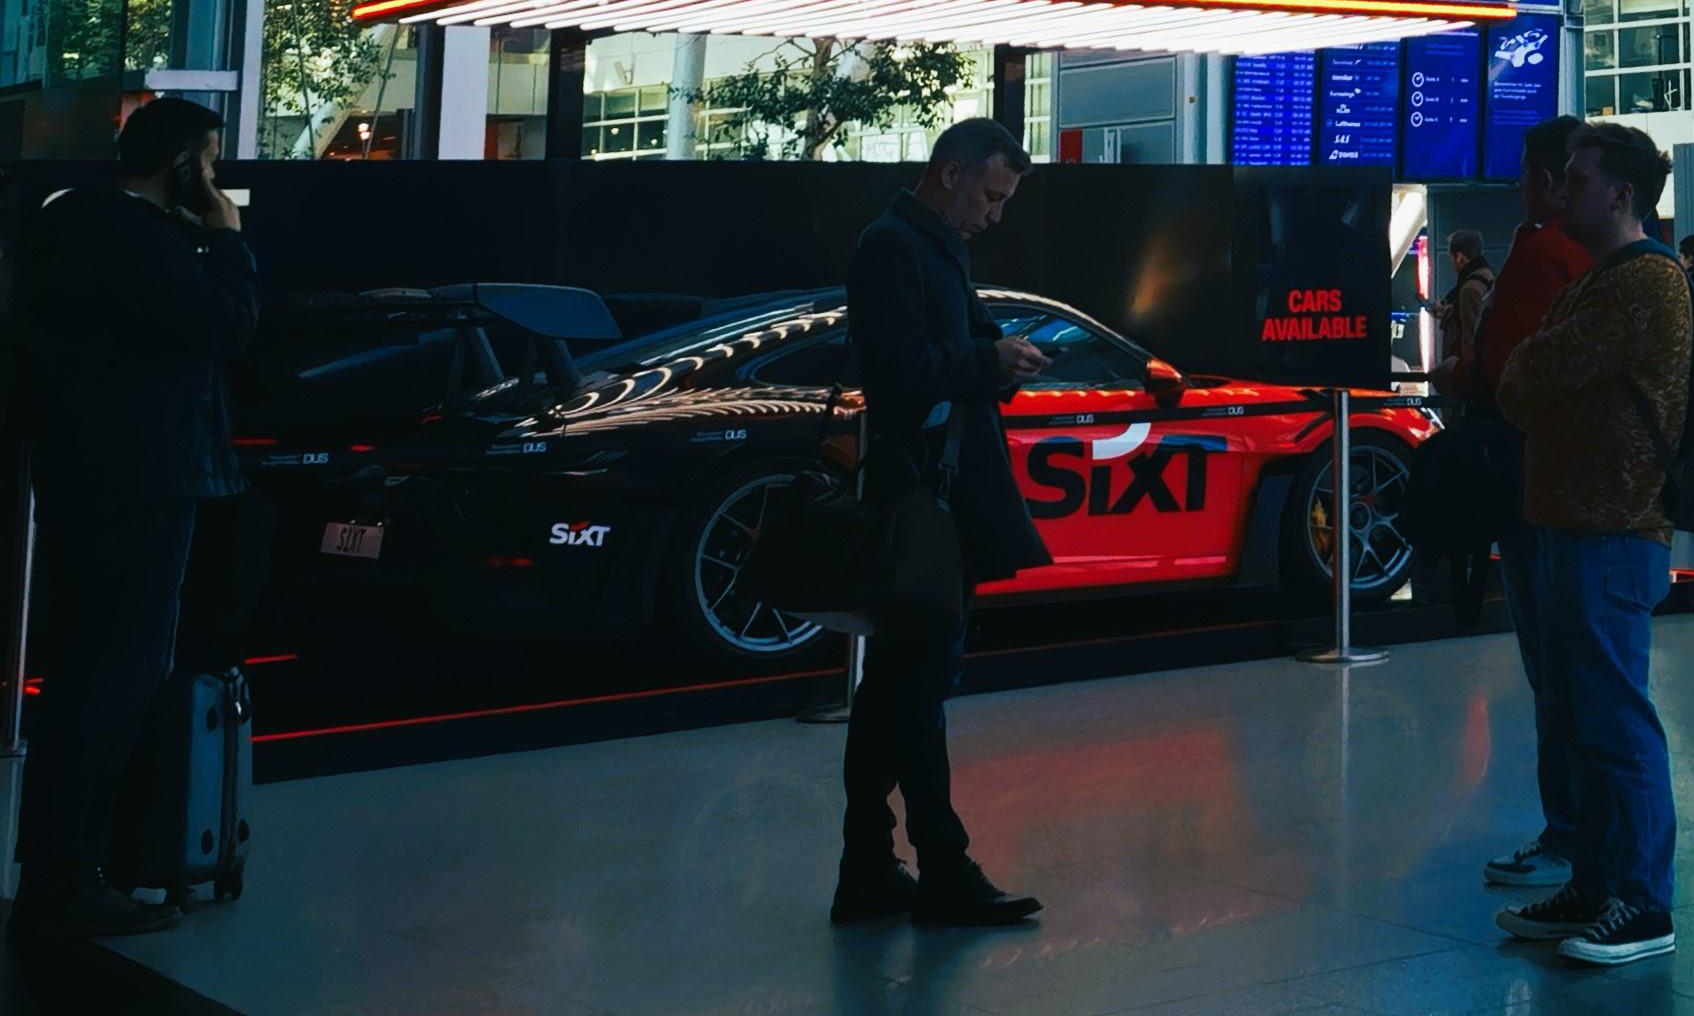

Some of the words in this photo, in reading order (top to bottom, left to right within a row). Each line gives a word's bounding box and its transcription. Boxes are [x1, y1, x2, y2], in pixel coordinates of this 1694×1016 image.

[1288, 289, 1342, 313] CARS
[1261, 316, 1368, 342] AVAILABLE
[303, 452, 329, 465] DUS
[336, 525, 366, 555] SIXT
